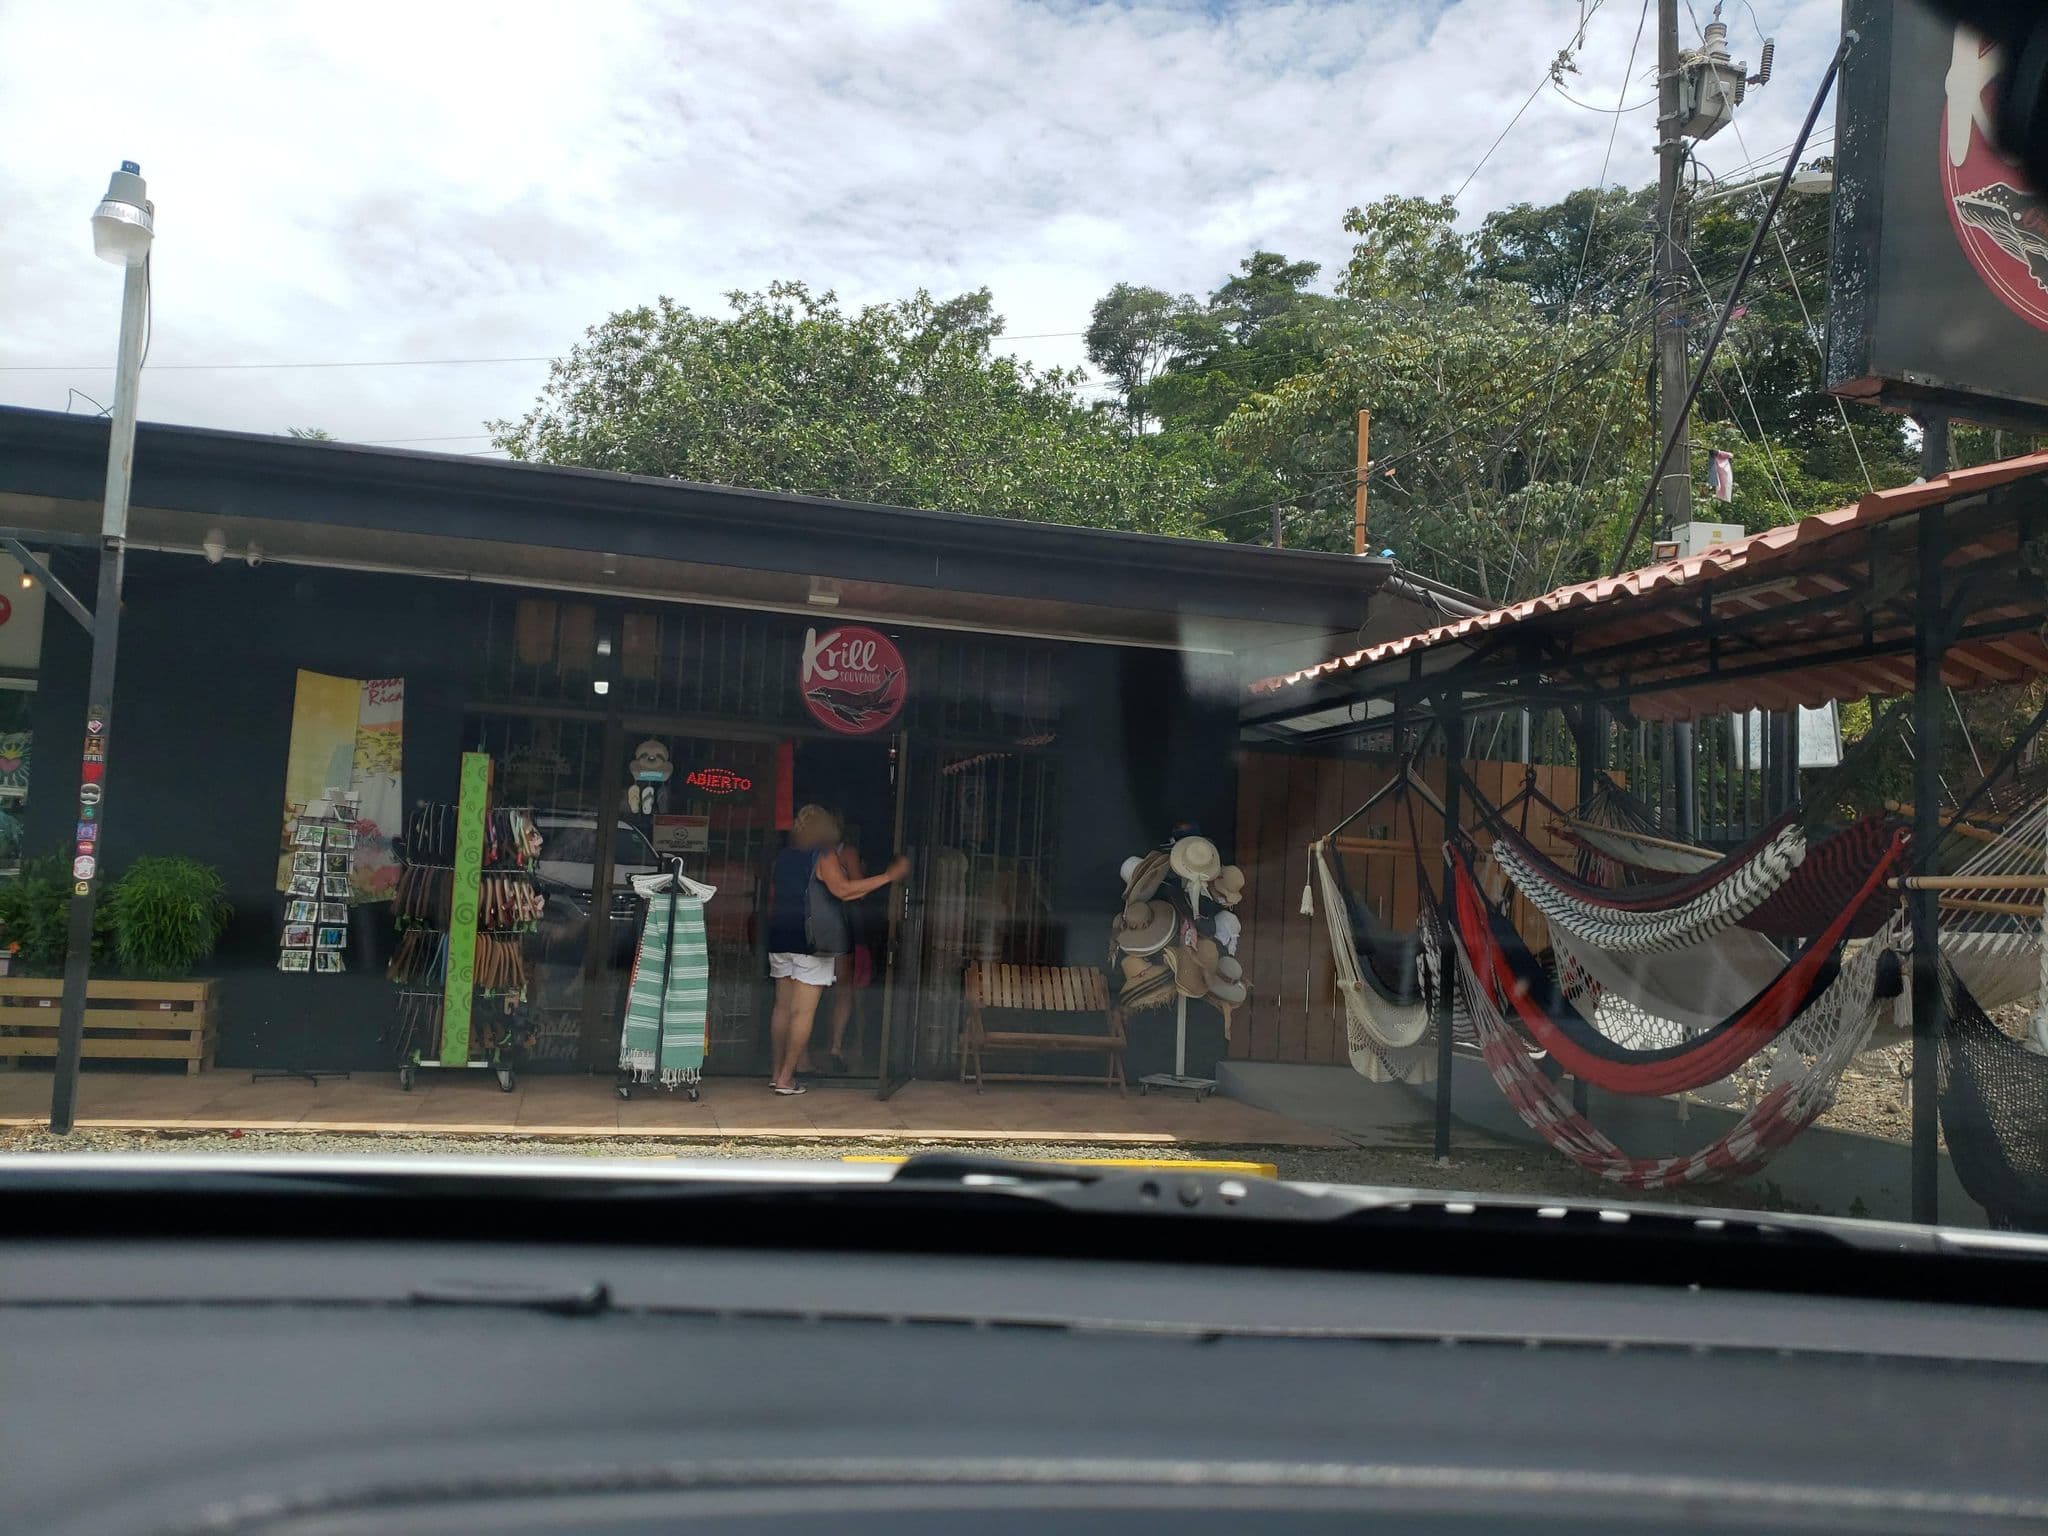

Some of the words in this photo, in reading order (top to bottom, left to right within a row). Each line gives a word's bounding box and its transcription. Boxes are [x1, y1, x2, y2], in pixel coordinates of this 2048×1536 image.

[802, 627, 879, 683] Krill
[368, 688, 402, 706] Rica
[685, 771, 752, 791] ABIERTO
